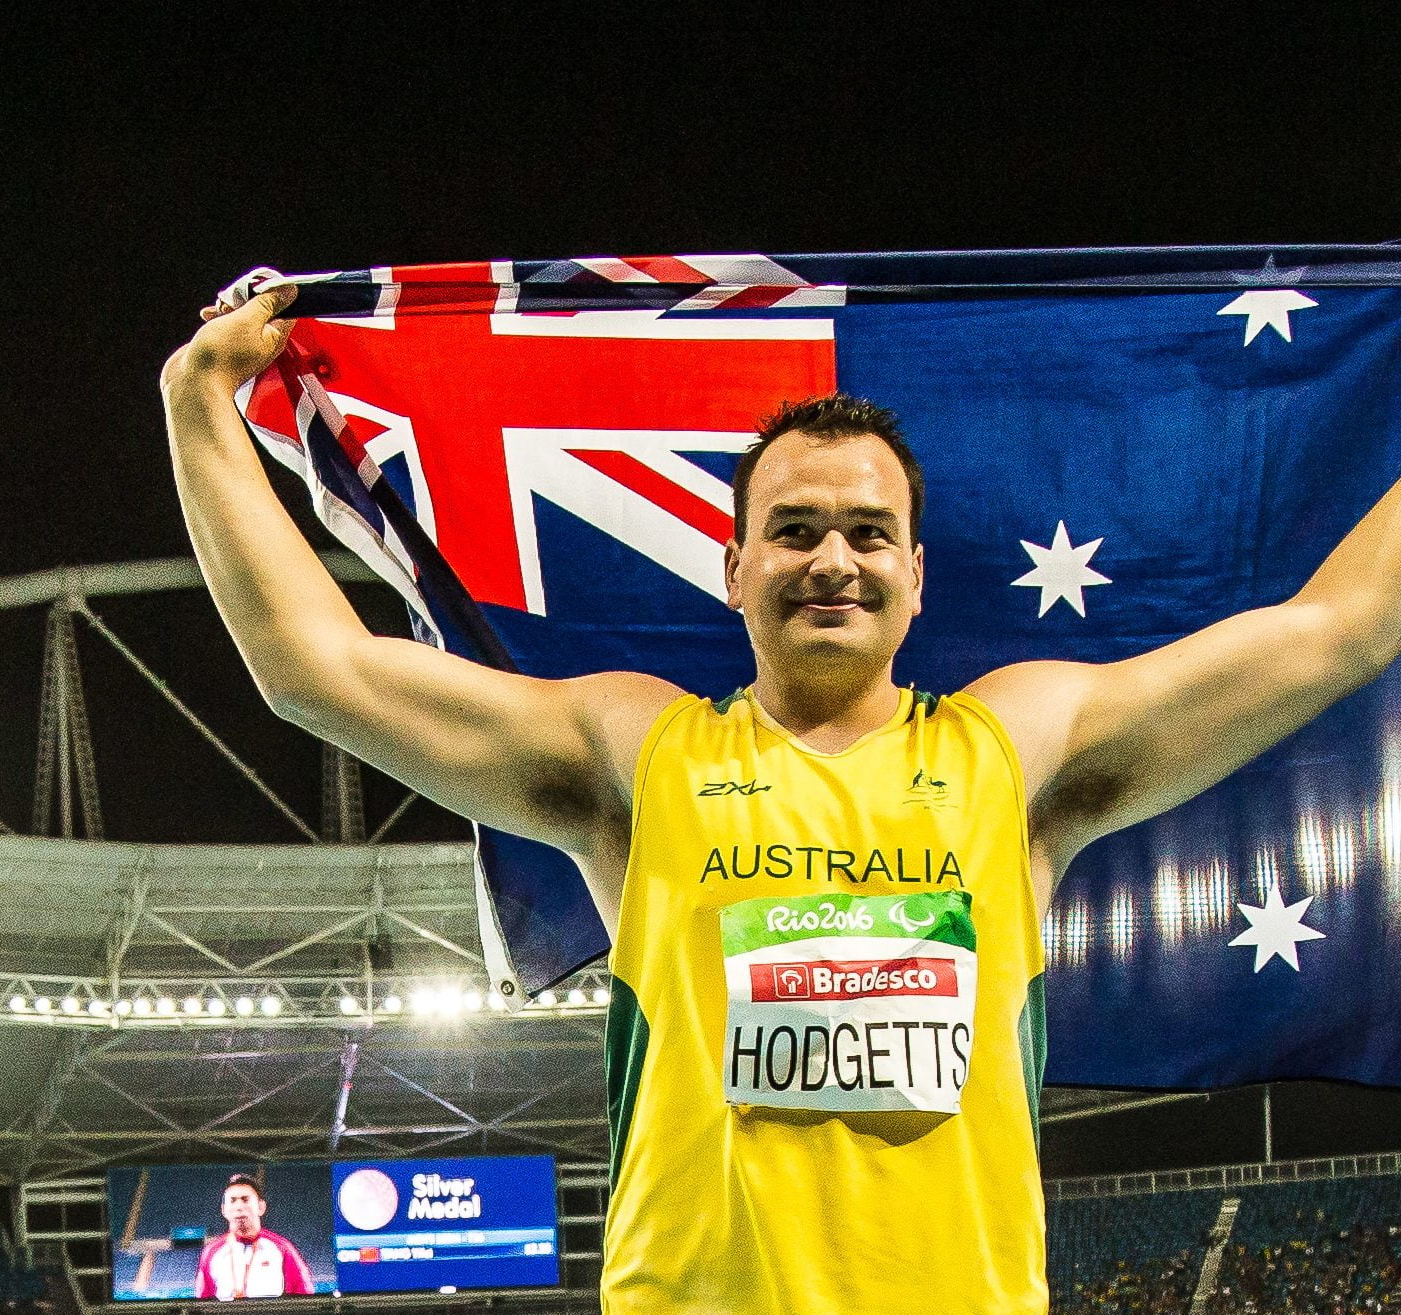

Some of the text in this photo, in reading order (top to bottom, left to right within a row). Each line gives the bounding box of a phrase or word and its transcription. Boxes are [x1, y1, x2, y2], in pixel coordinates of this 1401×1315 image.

[700, 845, 965, 887] AUSTRALIA
[765, 902, 874, 933] Rio2016
[811, 966, 937, 995] Bradesco
[731, 1021, 970, 1093] HODGETTS
[412, 1174, 474, 1197] Silver
[408, 1194, 481, 1219] Medal
